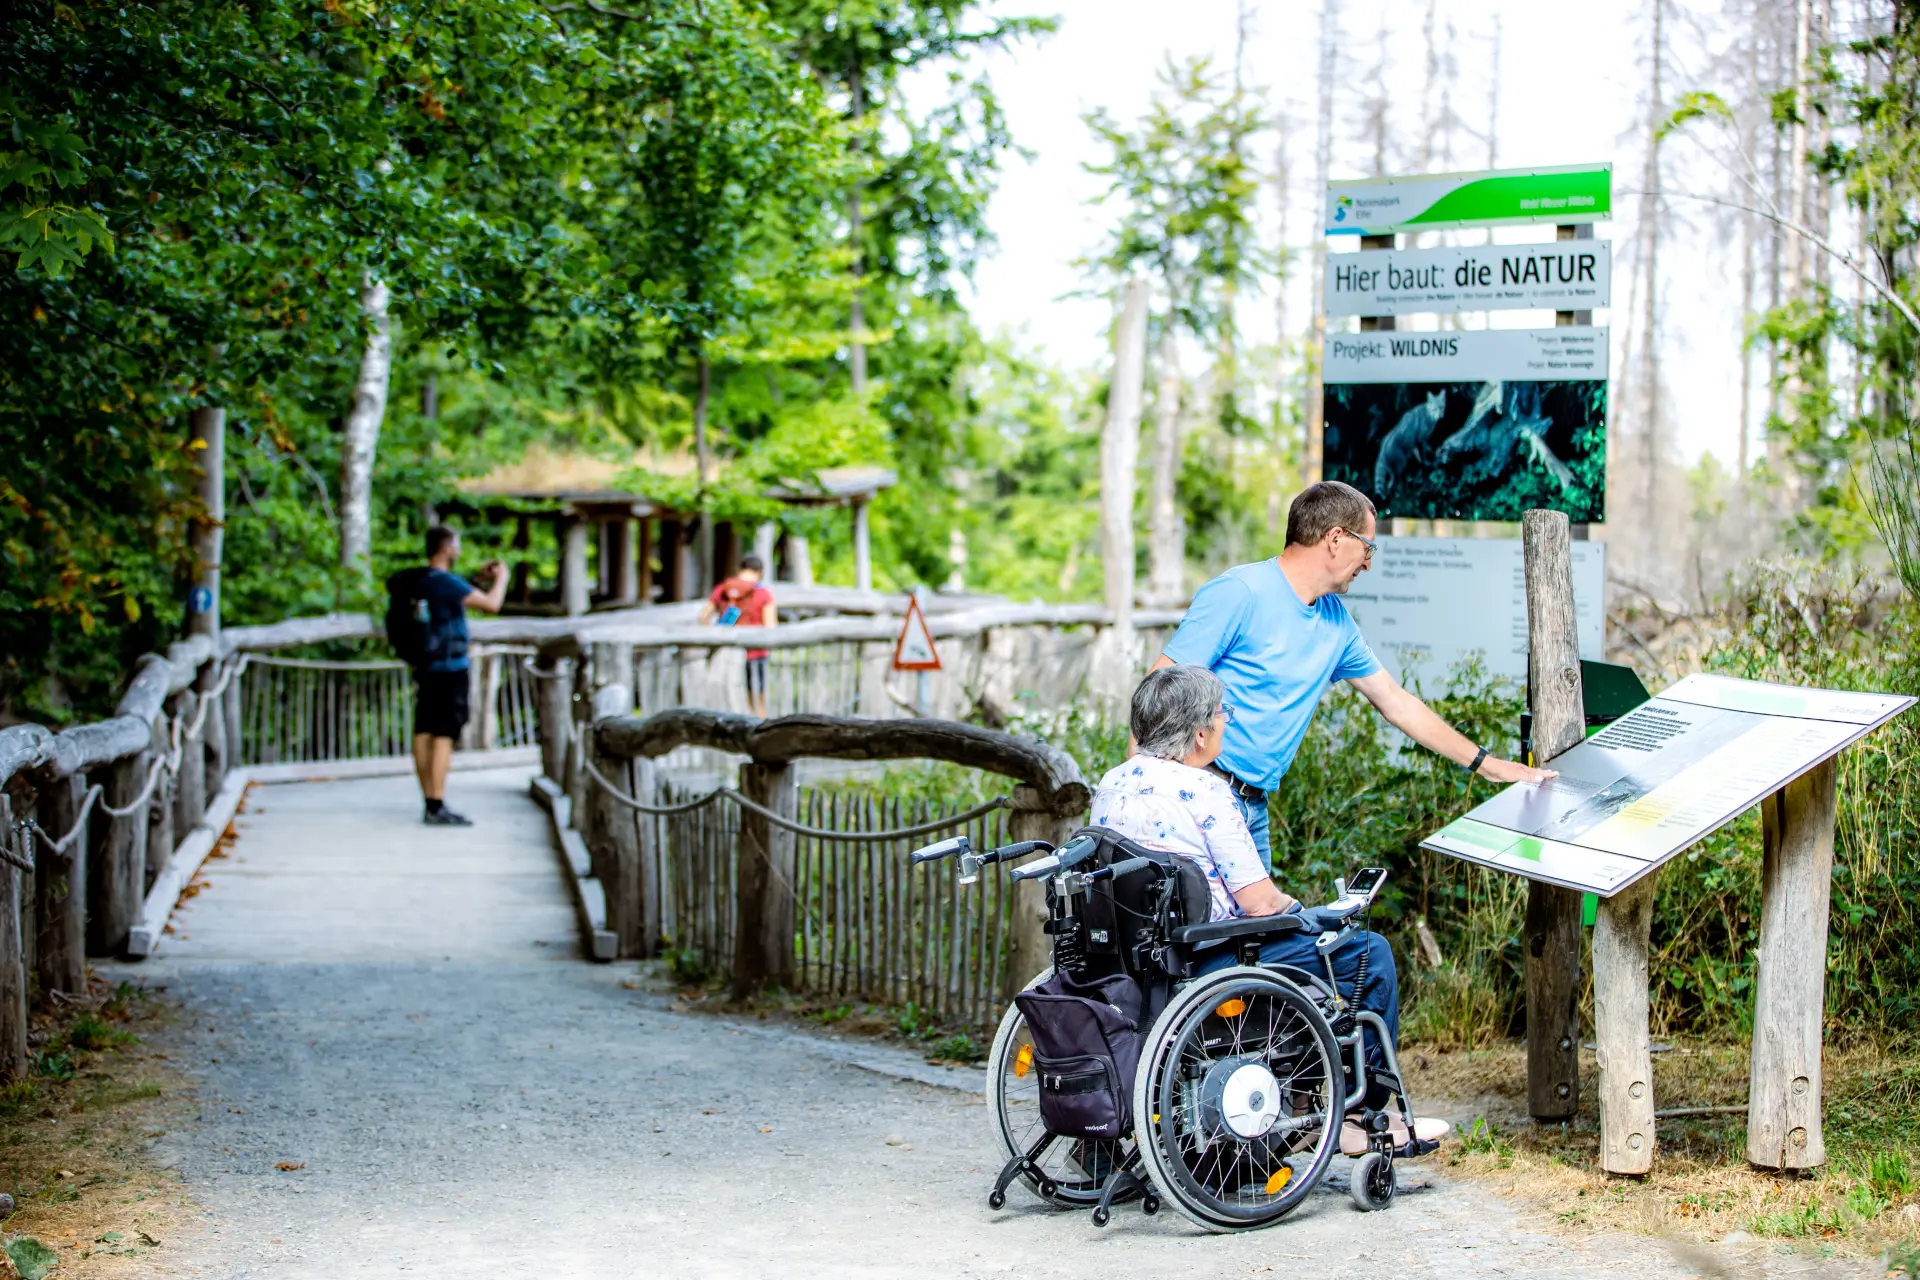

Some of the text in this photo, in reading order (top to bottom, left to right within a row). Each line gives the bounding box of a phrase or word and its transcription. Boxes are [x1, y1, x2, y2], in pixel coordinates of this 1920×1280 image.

[1336, 254, 1596, 292] Hier baut: die NATUR
[1334, 338, 1459, 363] Projekt: WILDNIS
